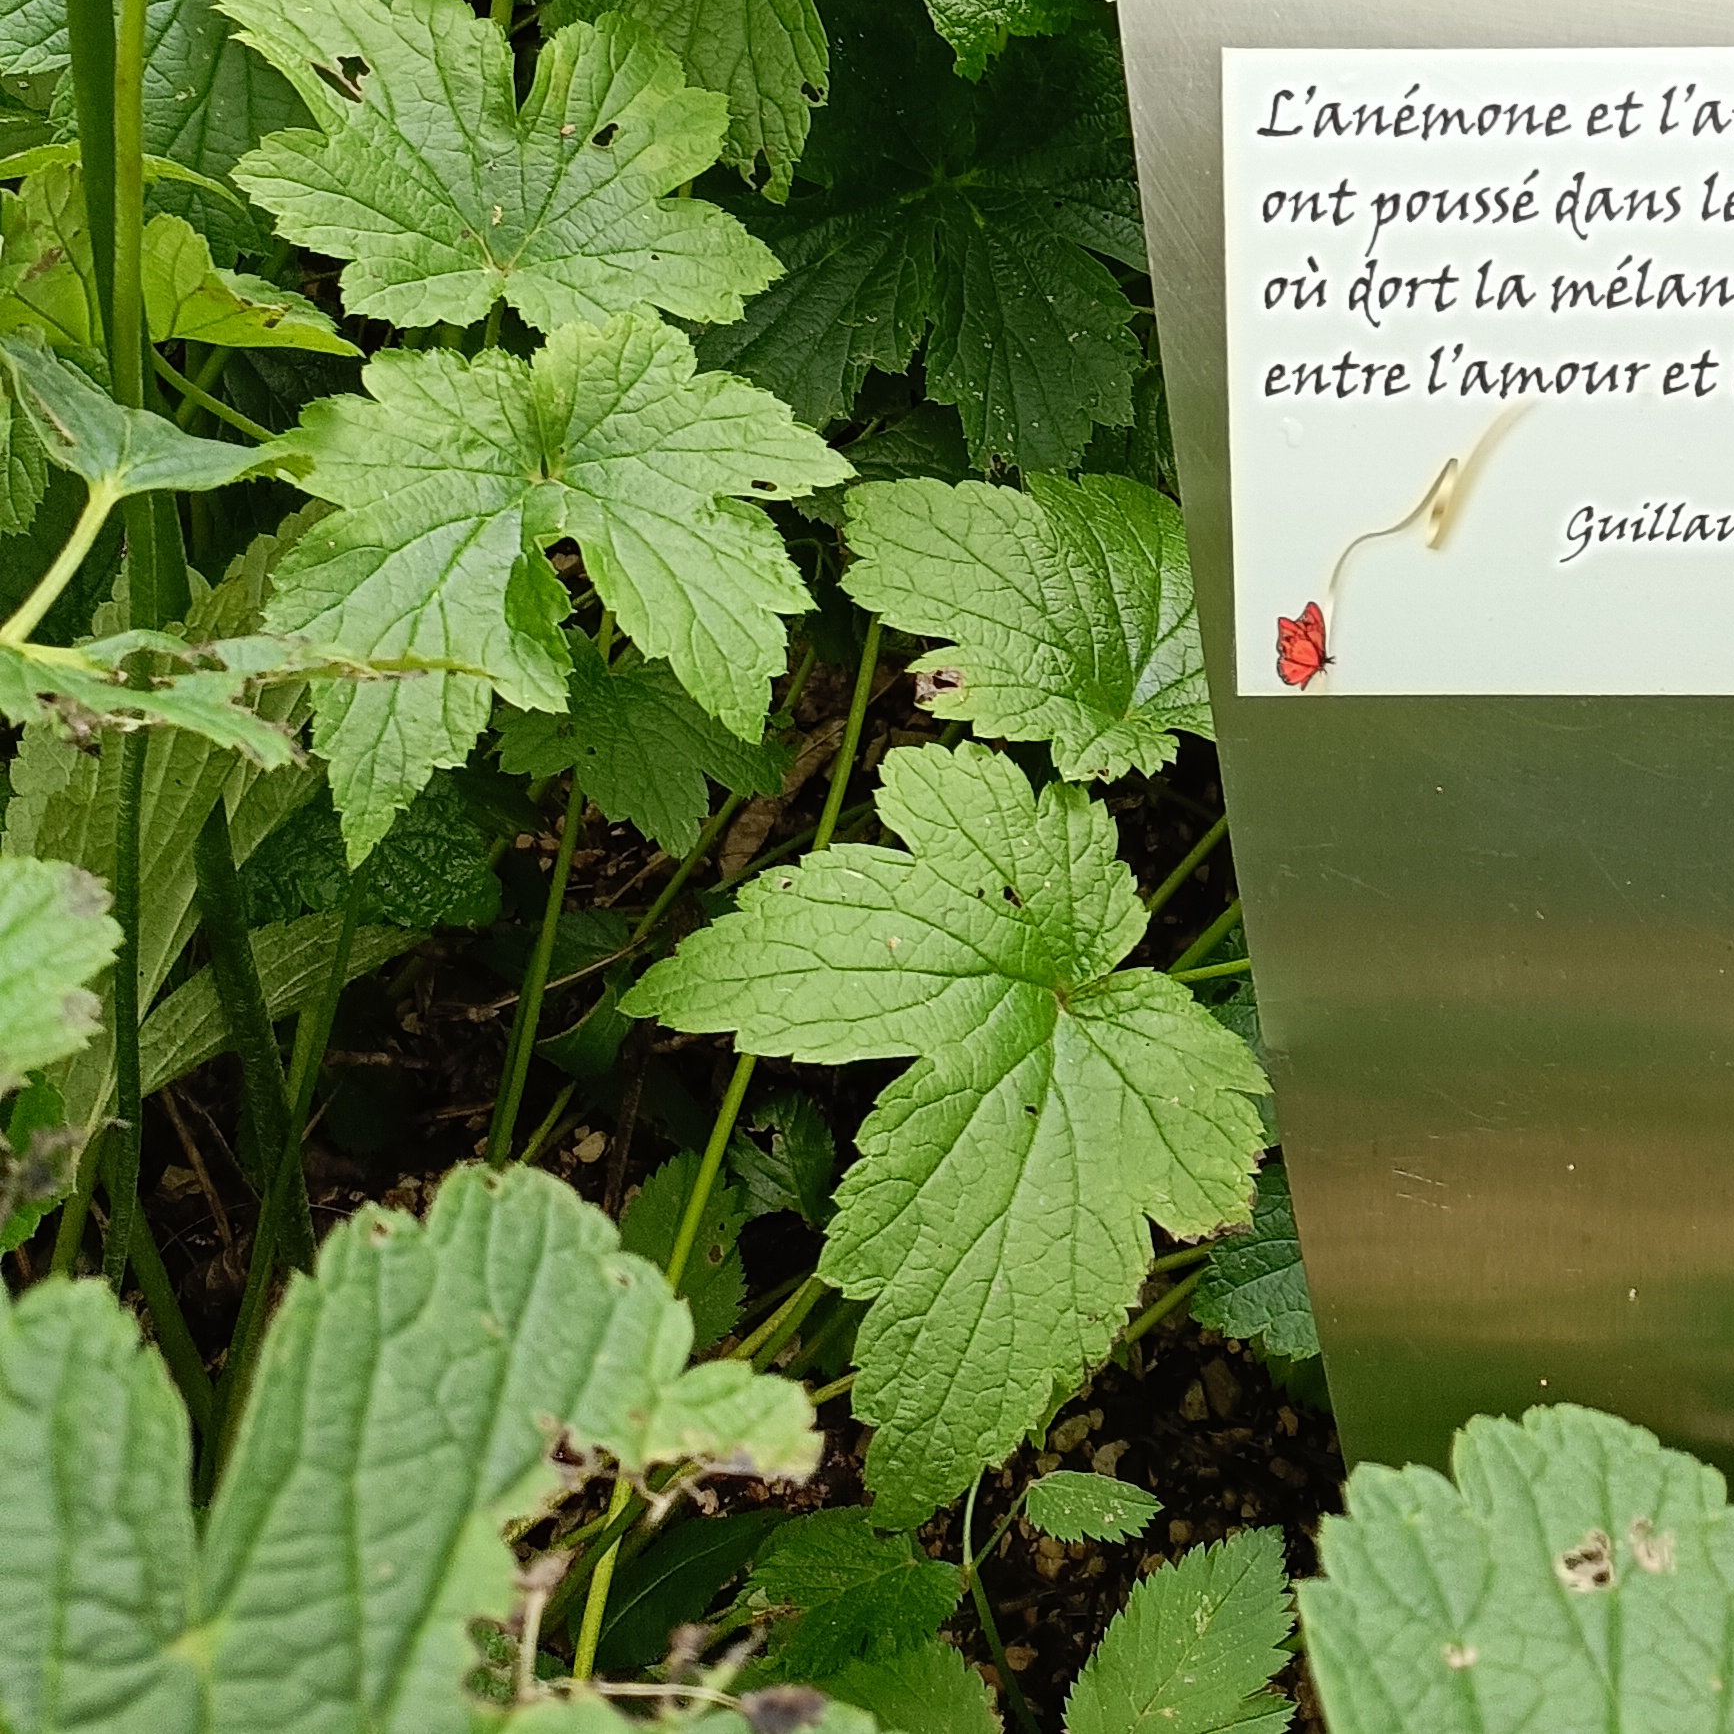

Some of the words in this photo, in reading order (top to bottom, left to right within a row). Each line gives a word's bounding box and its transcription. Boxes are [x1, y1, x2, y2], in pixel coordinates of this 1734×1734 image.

[1255, 82, 1572, 142] L'anémone
[1585, 90, 1644, 140] et
[1261, 177, 1358, 228] ont
[1363, 168, 1540, 259] poussé
[1554, 170, 1682, 242] dans
[1263, 255, 1328, 311] où
[1347, 258, 1460, 330] dort
[1474, 258, 1537, 312] la
[1263, 350, 1412, 400] entre
[1426, 342, 1652, 401] l'amour
[1661, 348, 1721, 399] et
